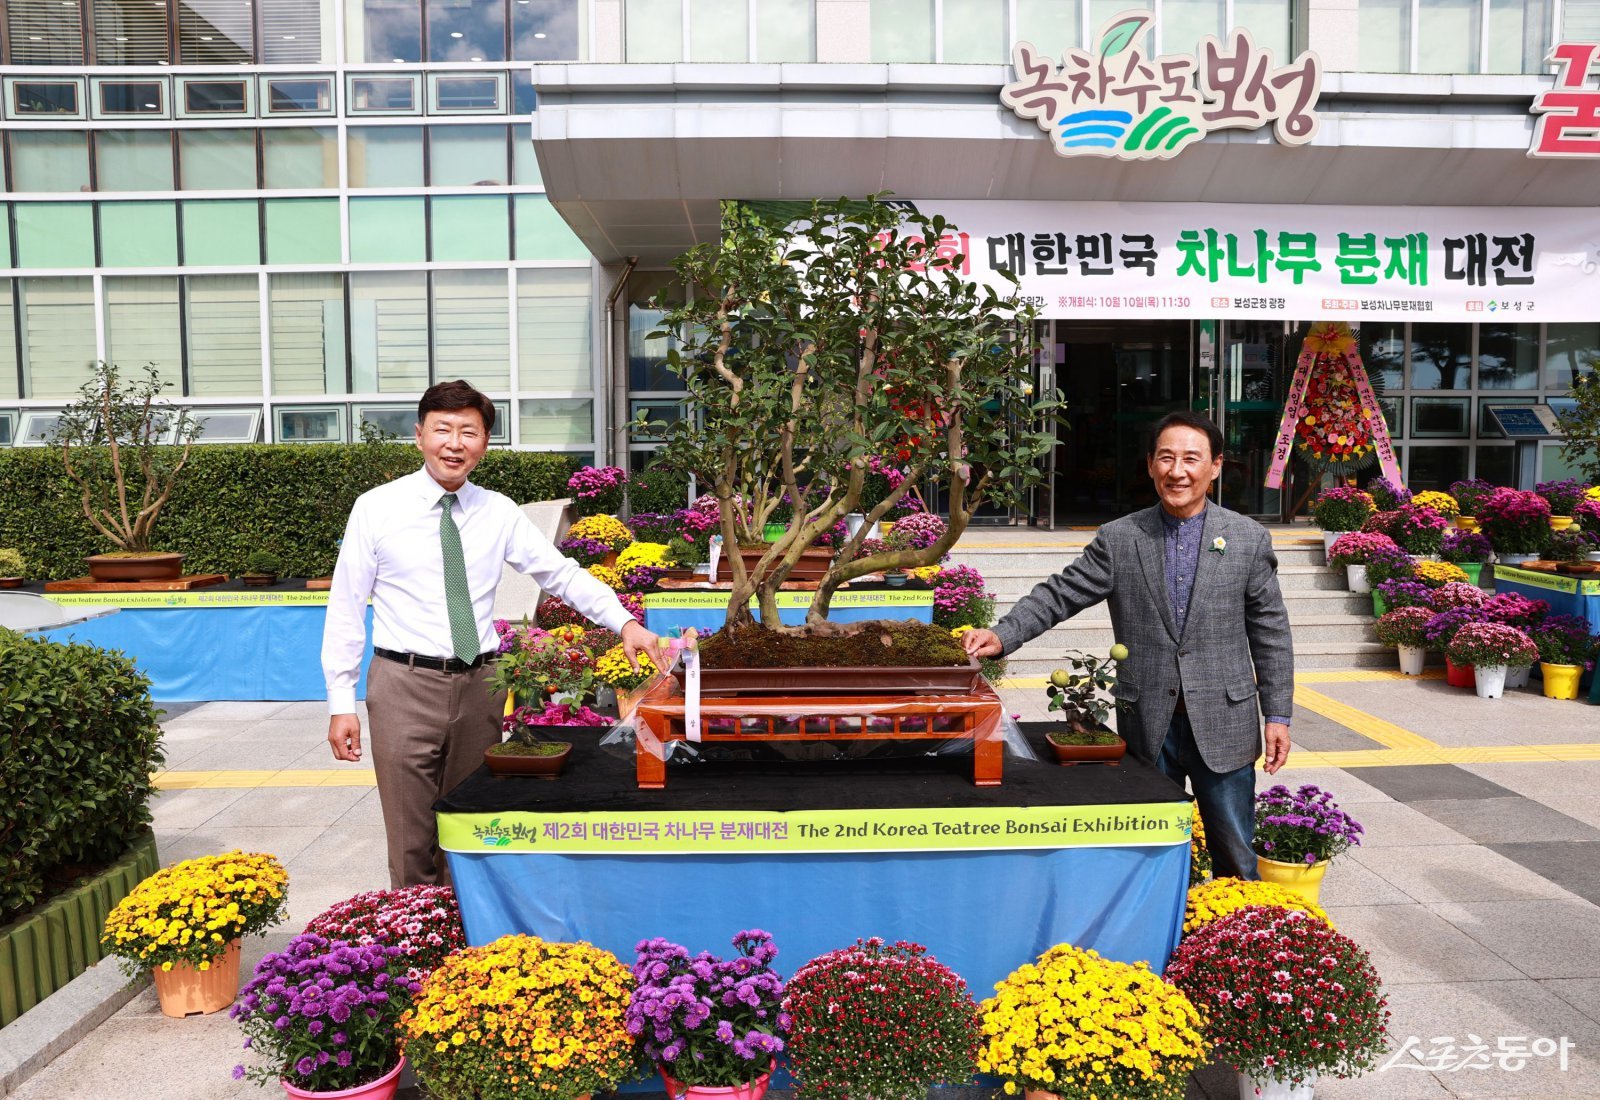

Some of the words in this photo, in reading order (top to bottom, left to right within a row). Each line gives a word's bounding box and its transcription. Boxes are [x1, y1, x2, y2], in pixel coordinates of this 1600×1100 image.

[1009, 41, 1196, 121] 녹차수도
[1202, 33, 1315, 135] 보성
[986, 232, 1158, 276] 대한민국
[1176, 228, 1322, 284] 차나무
[1335, 231, 1429, 286] 분재
[1443, 232, 1536, 286] 대전
[1099, 297, 1121, 308] 10월
[1162, 297, 1190, 308] 11:30
[1234, 297, 1267, 309] 보성군청
[1269, 297, 1286, 309] 광장
[512, 822, 537, 843] 보성
[542, 822, 587, 840] 제2회
[592, 821, 661, 840] 대한민국
[664, 821, 716, 840] 차나무
[719, 821, 788, 840] 분재대전
[798, 823, 829, 838] The
[835, 822, 868, 837] 2nd
[873, 821, 928, 837] Korea
[932, 820, 1001, 836] Teatree
[1006, 818, 1067, 834] Bonsai
[1073, 815, 1169, 833] Exhibition
